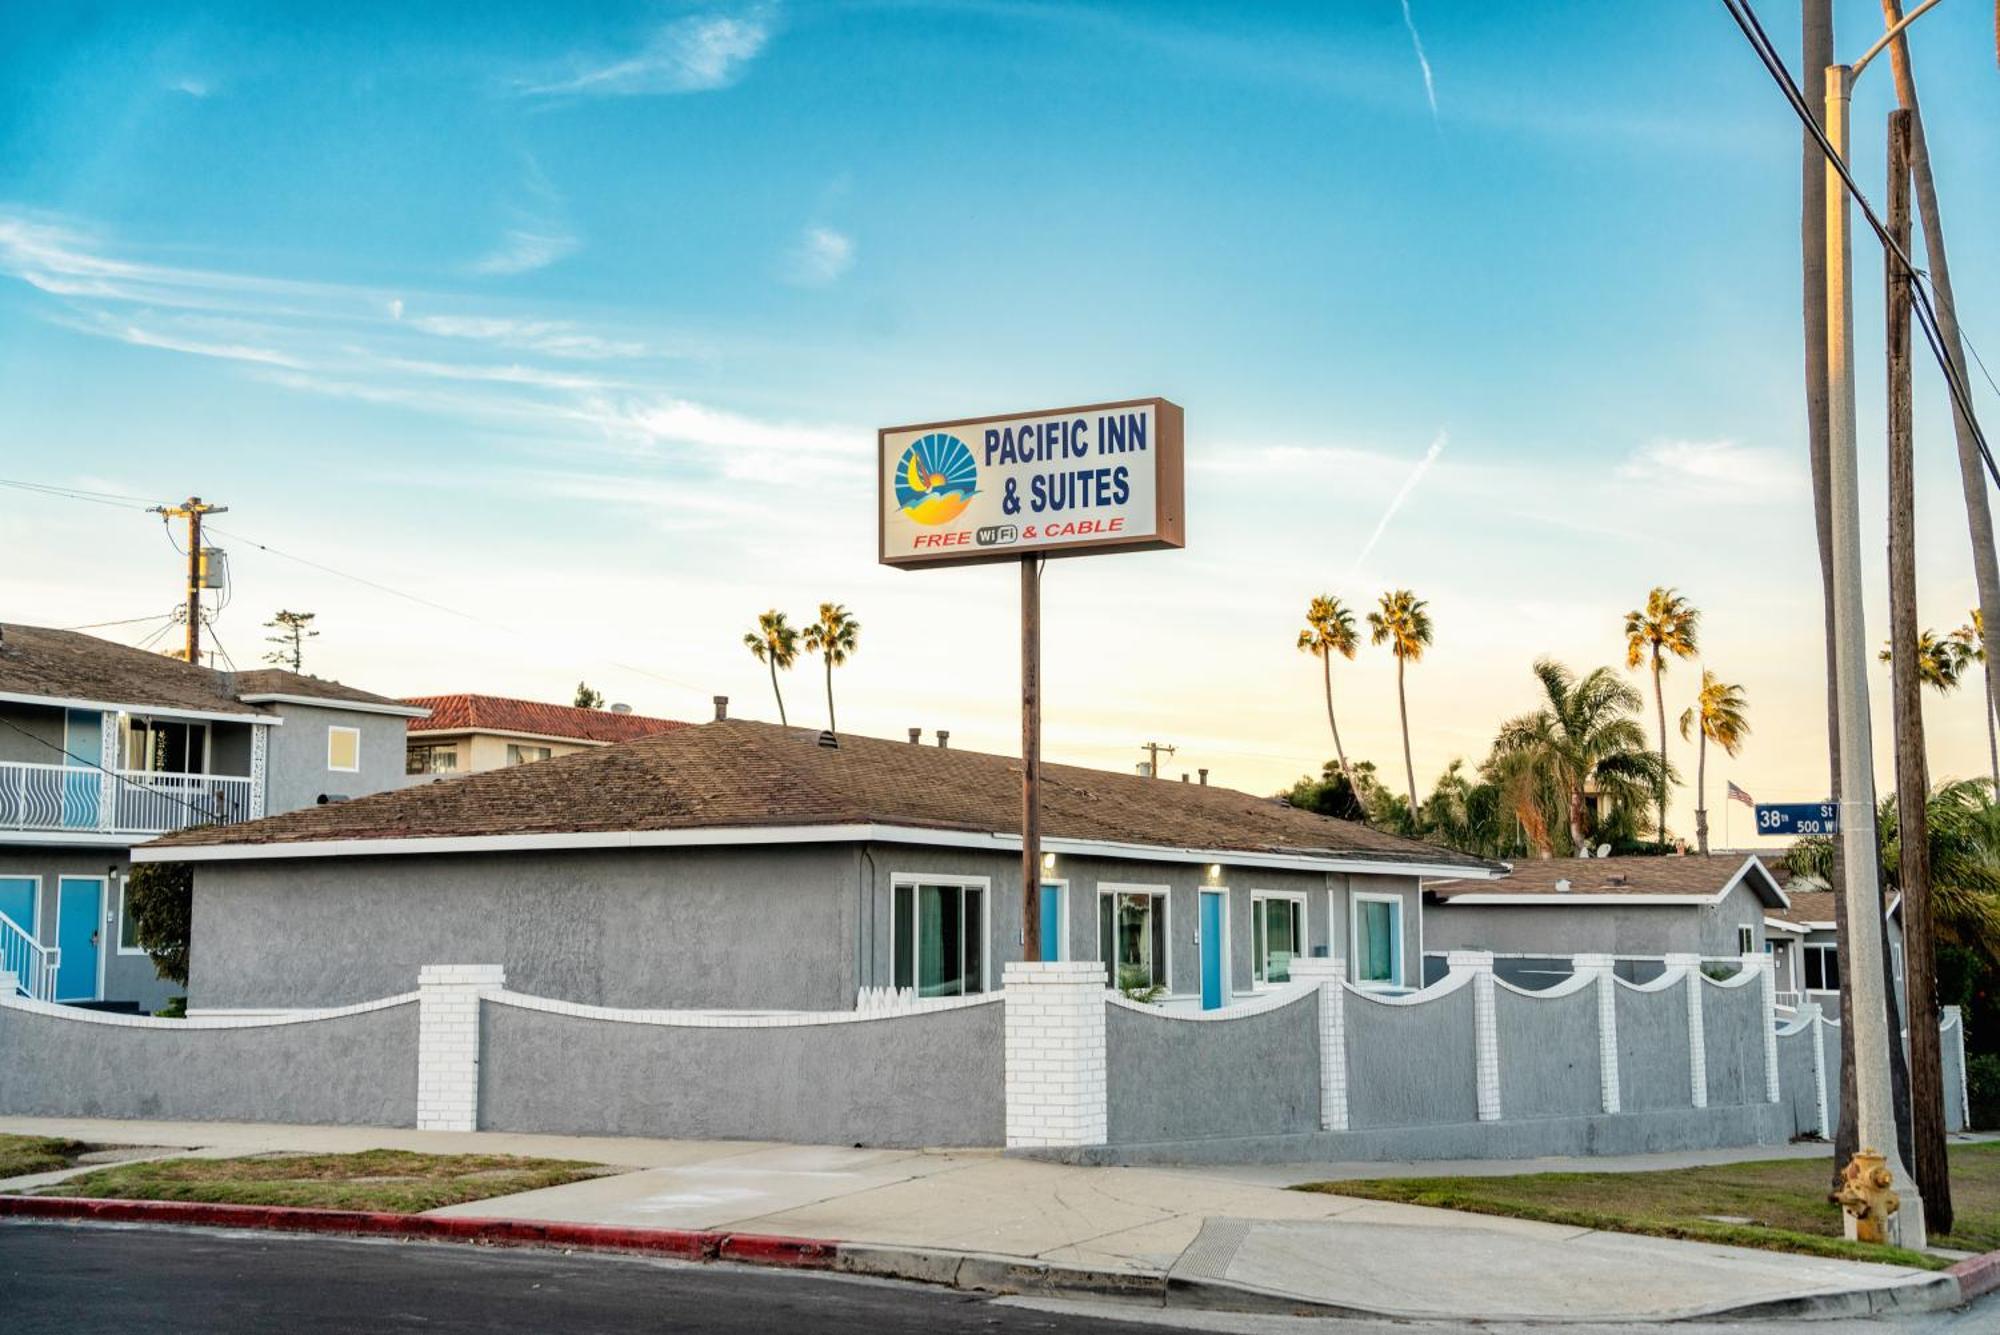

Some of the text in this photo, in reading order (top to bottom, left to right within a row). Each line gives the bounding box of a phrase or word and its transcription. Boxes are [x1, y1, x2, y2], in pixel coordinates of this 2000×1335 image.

[985, 413, 1147, 466] PACIFIC INN
[1002, 466, 1130, 515] & SUITES
[913, 531, 971, 548] FREE
[1022, 526, 1037, 538] &
[1044, 518, 1125, 537] CABLE
[1821, 806, 1833, 817] St
[1797, 821, 1834, 833] 500 W
